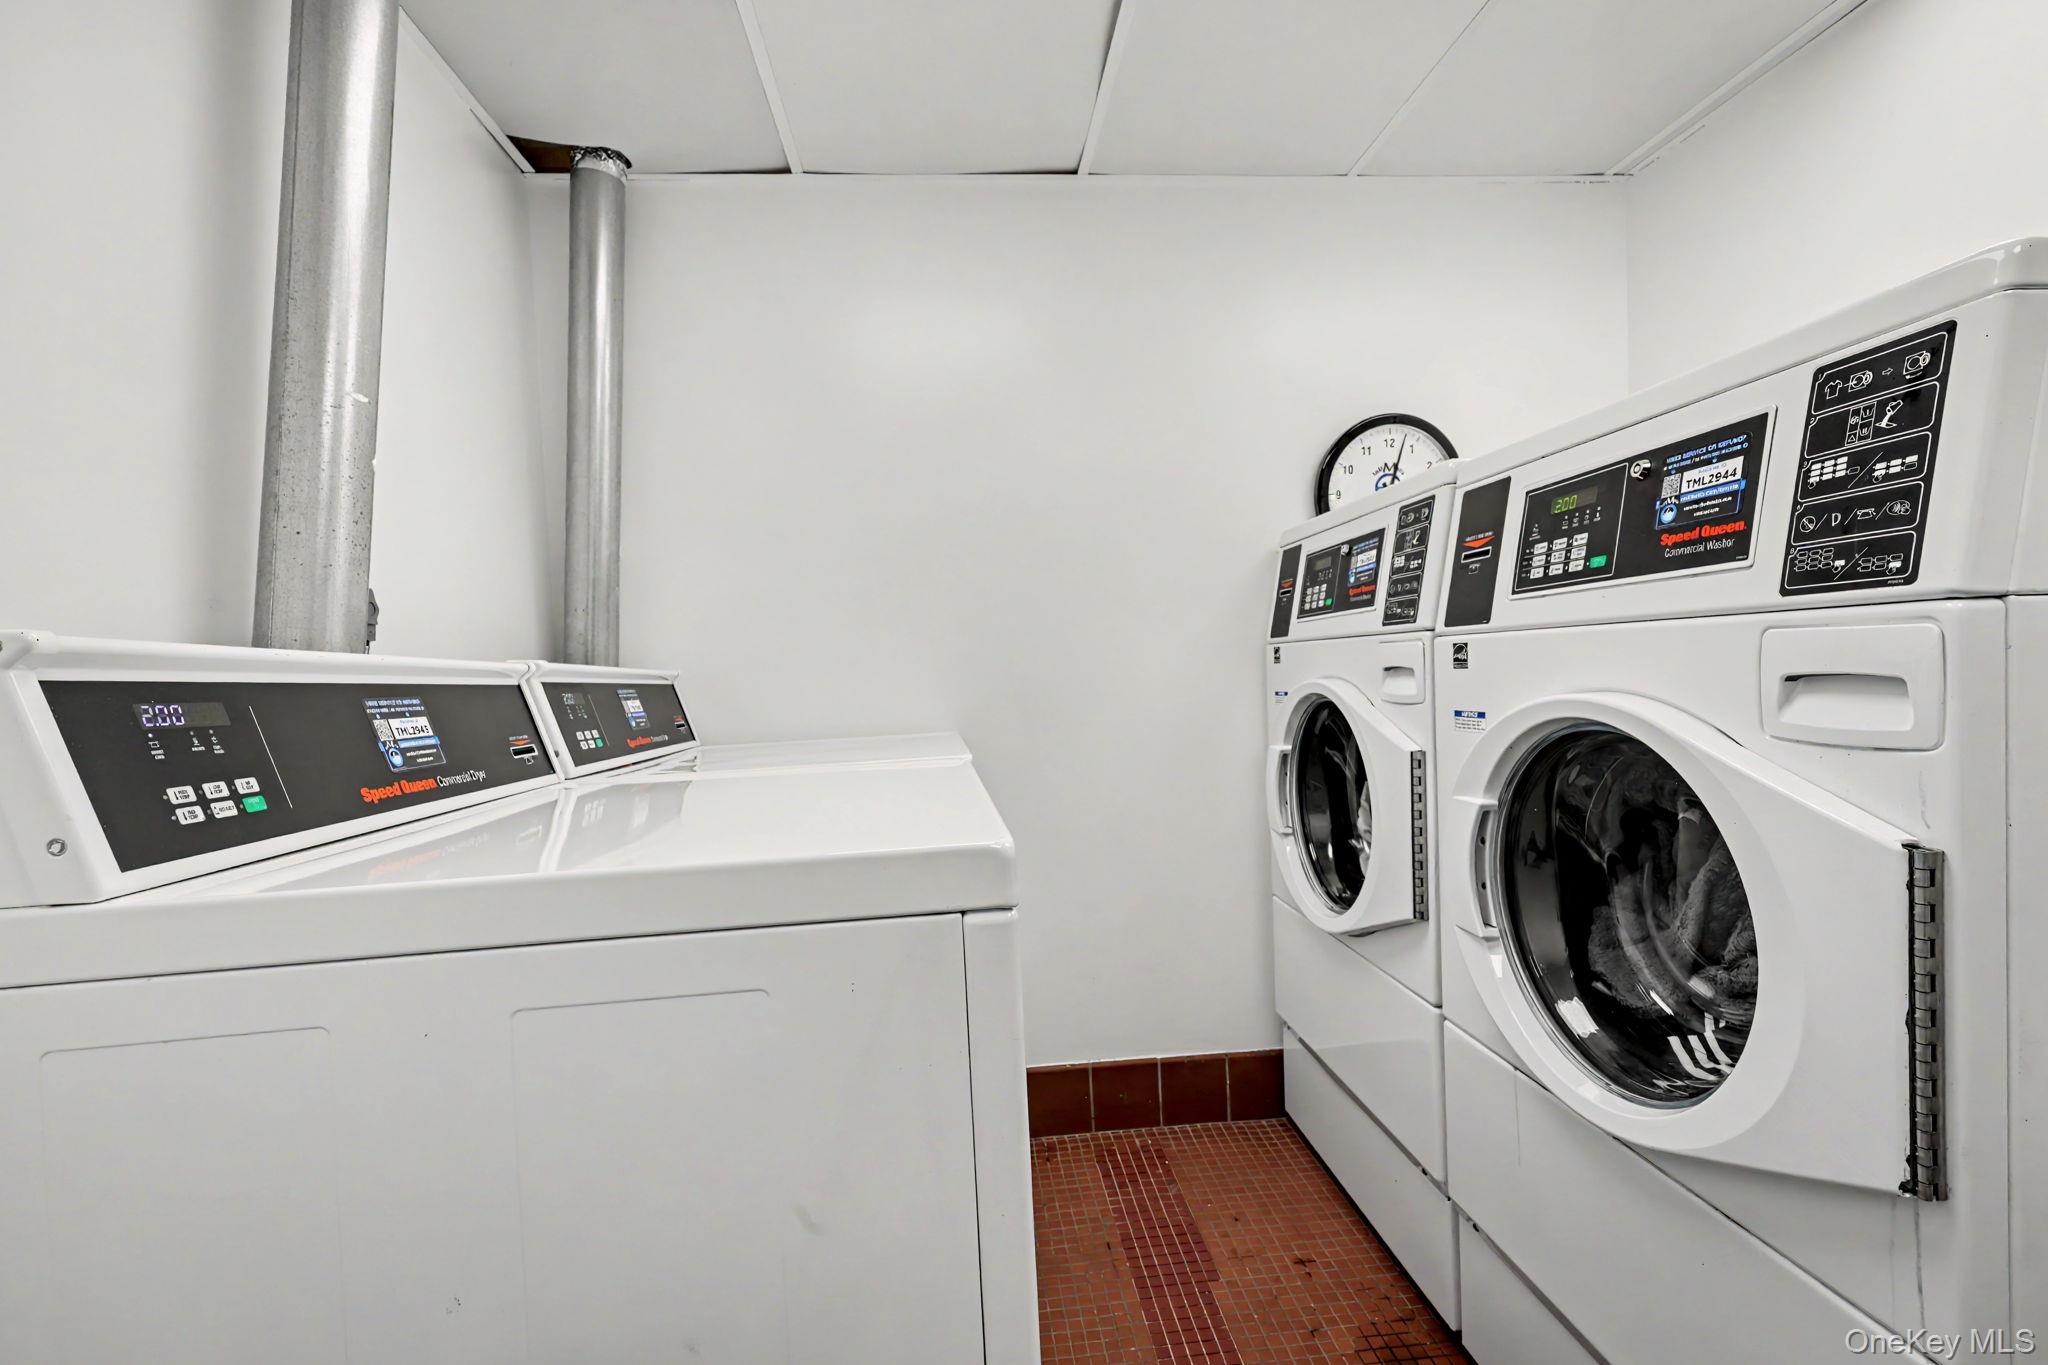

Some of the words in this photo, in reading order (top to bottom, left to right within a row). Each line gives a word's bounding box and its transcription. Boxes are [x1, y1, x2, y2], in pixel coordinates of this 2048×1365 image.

[1361, 446, 1372, 455] 11
[1384, 438, 1395, 448] 12
[1409, 444, 1415, 454] 1
[1343, 465, 1354, 475] 10
[1686, 467, 1738, 489] TML2944
[1335, 489, 1342, 499] 9
[1660, 527, 1700, 546] Speed
[1701, 520, 1745, 537] Queen
[1664, 541, 1705, 558] Commercial
[1706, 537, 1736, 551] Washer
[140, 704, 186, 727] 2.00
[360, 782, 402, 804] Speed
[401, 778, 438, 794] Queen
[436, 770, 470, 787] Commercial
[470, 769, 487, 782] Dryer
